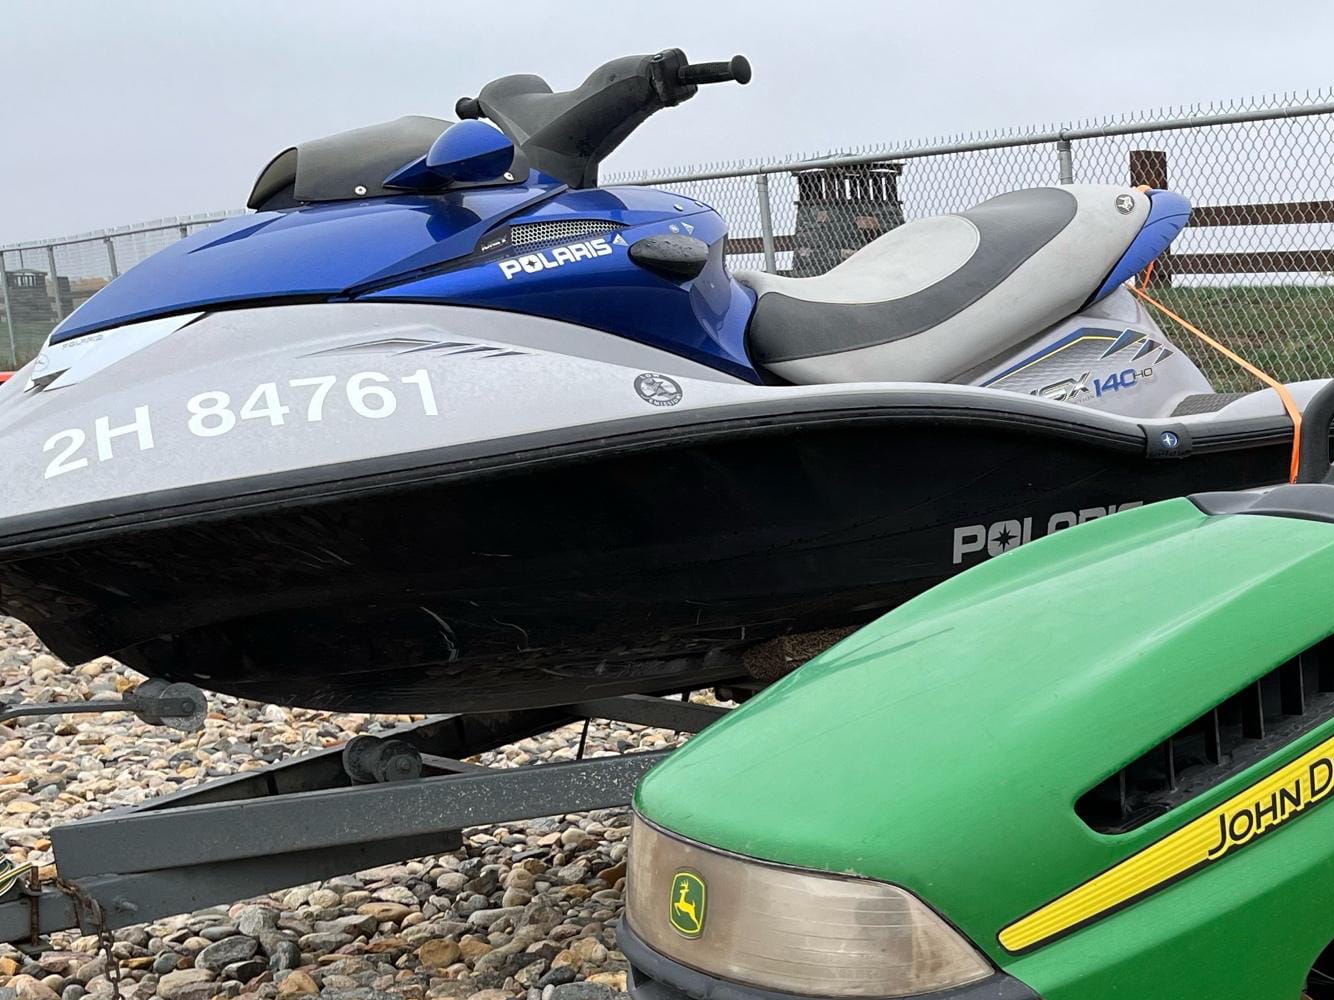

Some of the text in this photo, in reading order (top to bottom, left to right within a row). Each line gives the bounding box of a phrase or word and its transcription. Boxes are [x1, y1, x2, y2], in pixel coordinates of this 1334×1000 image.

[498, 238, 613, 280] POLARIS
[1029, 371, 1091, 402] SX
[42, 368, 439, 480] 2H 84761
[1207, 779, 1302, 858] JOHN
